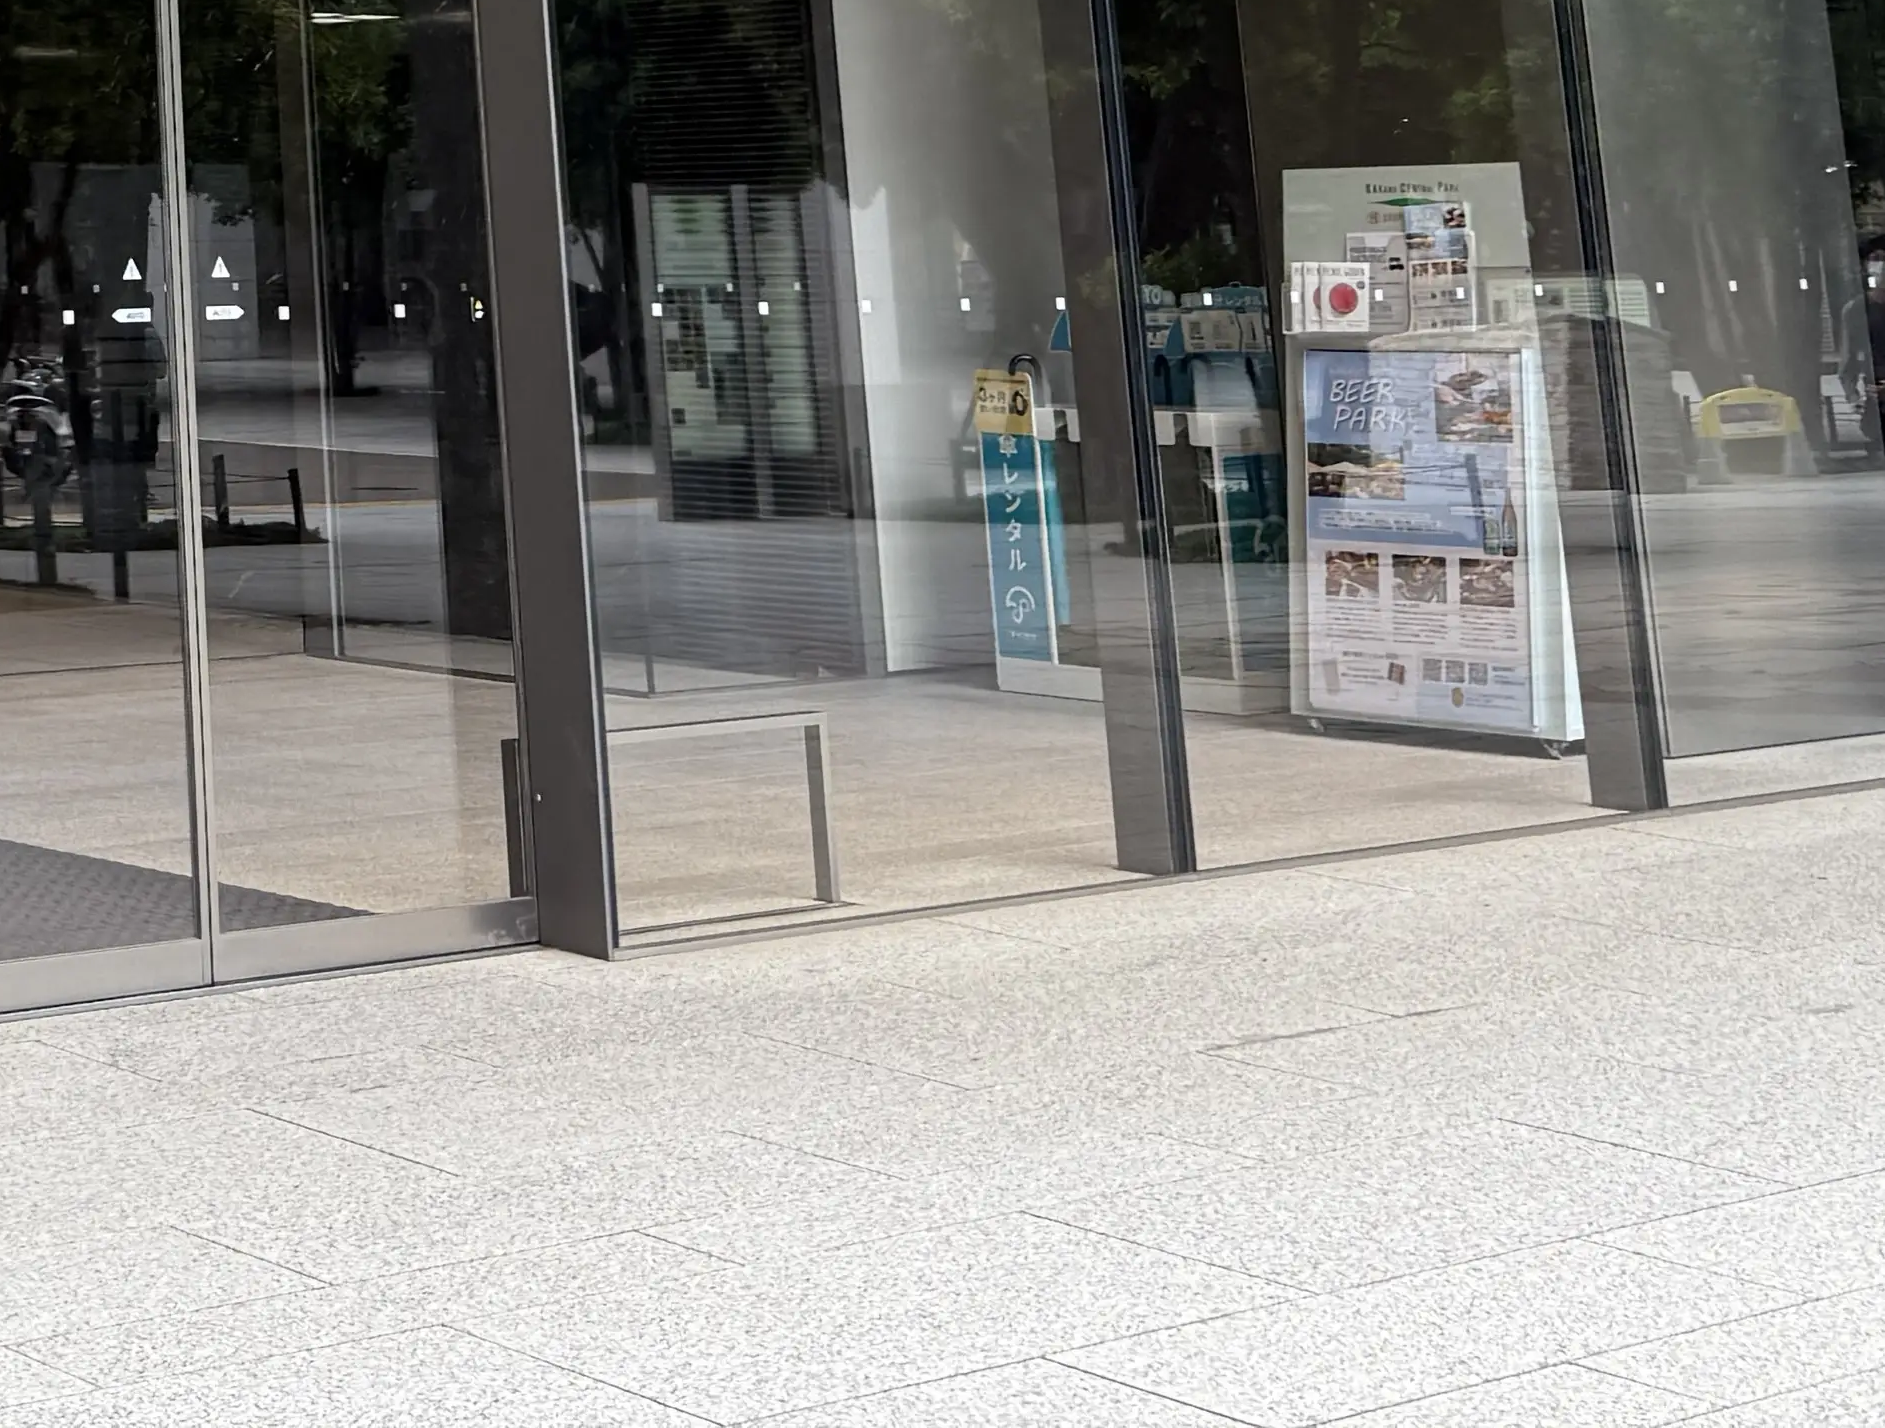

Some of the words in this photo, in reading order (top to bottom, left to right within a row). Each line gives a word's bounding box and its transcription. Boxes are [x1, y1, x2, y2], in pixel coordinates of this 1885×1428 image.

[1329, 376, 1395, 404] BEER
[997, 434, 1027, 573] 傘レンタル
